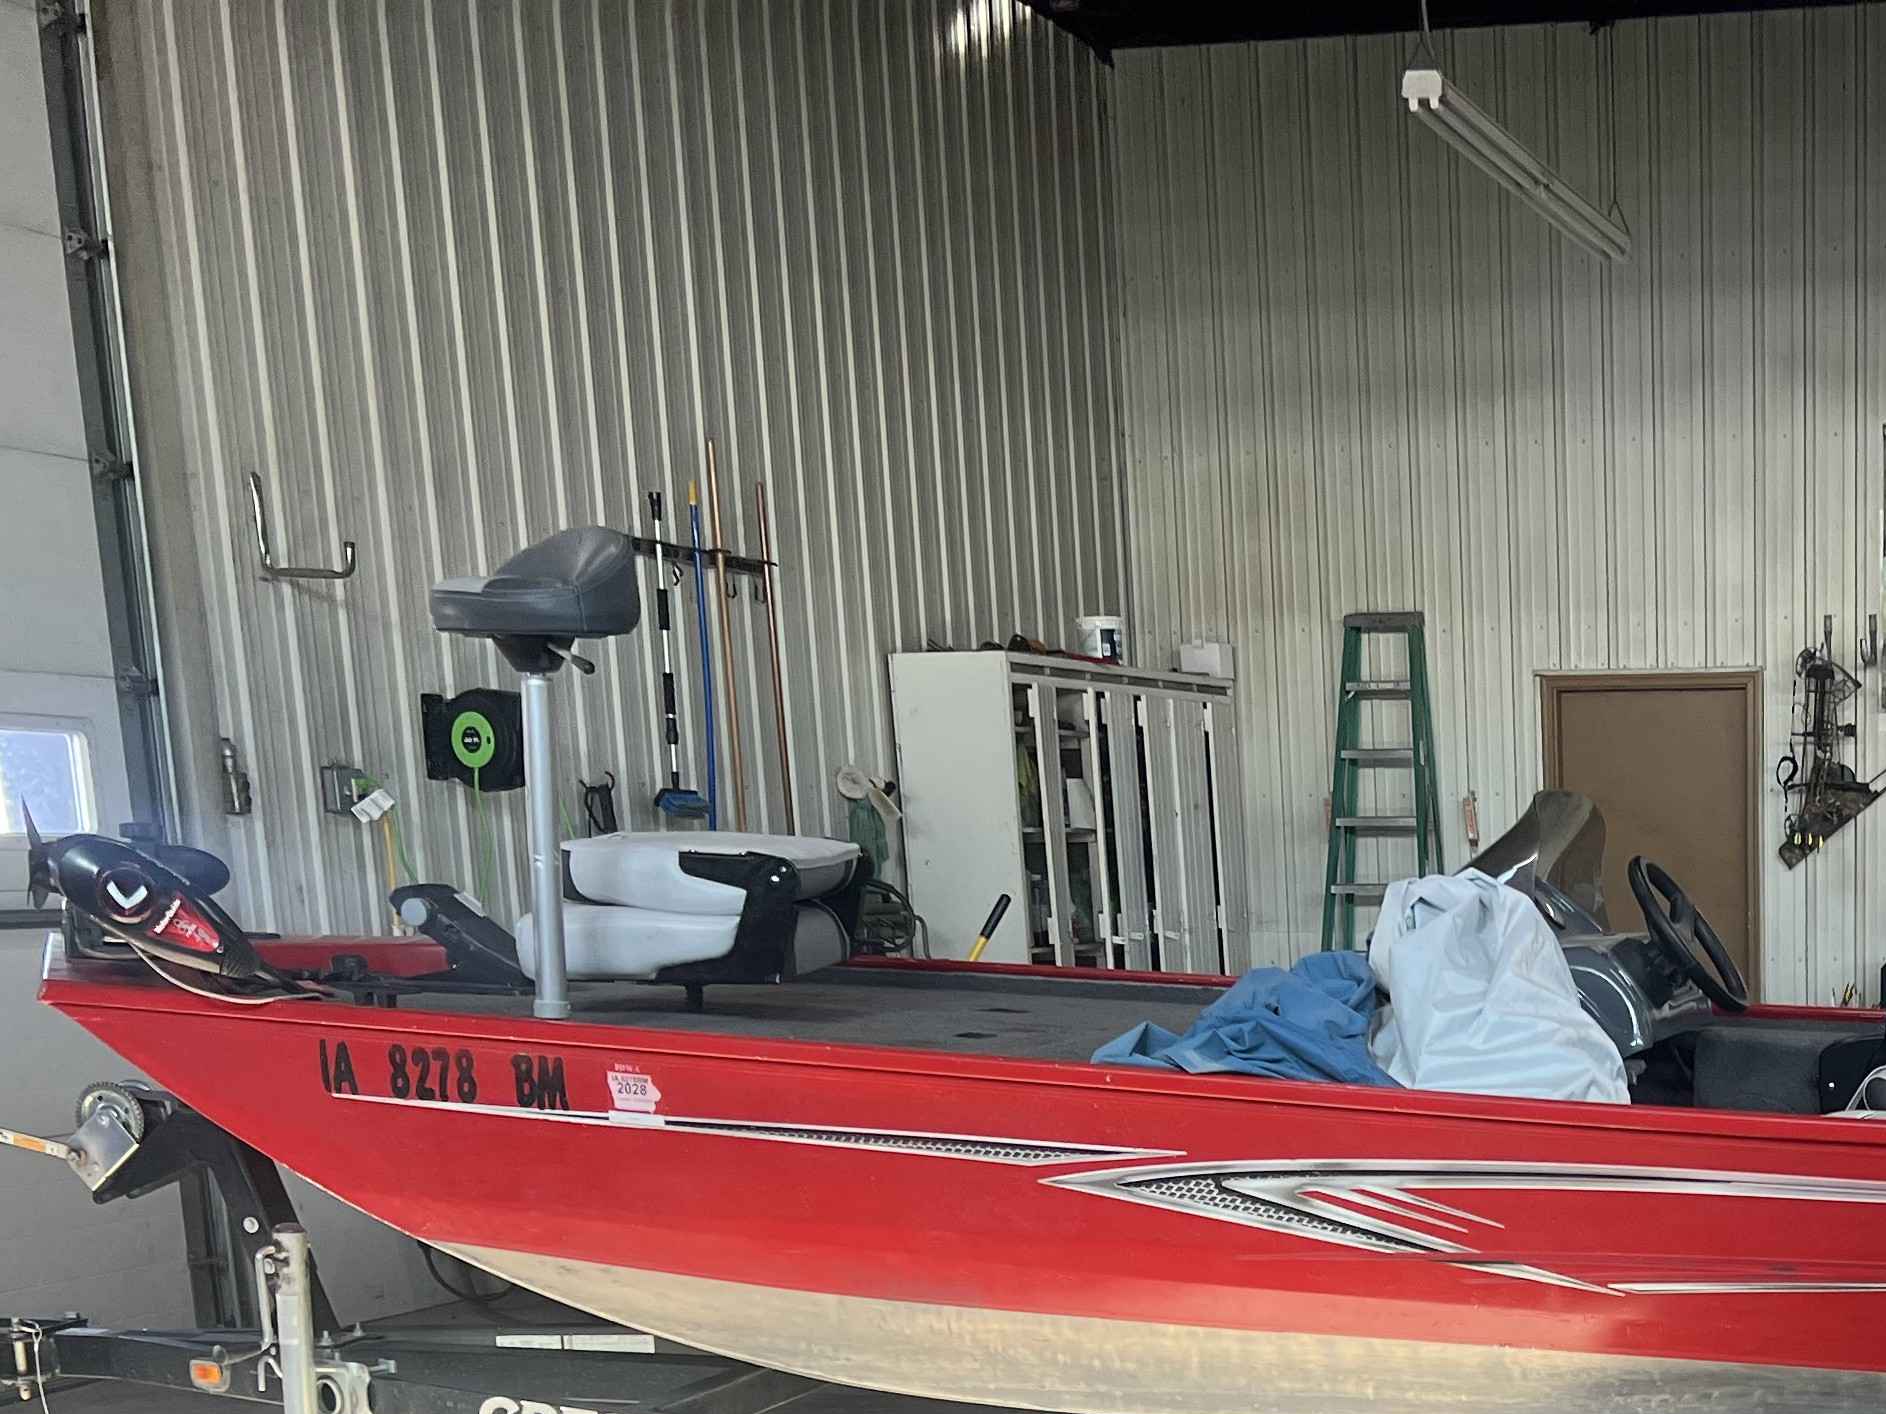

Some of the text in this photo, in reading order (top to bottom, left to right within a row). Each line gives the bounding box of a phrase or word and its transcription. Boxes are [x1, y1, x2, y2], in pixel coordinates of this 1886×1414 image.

[319, 1039, 570, 1111] IA 8278 BM
[617, 1082, 647, 1096] 2028
